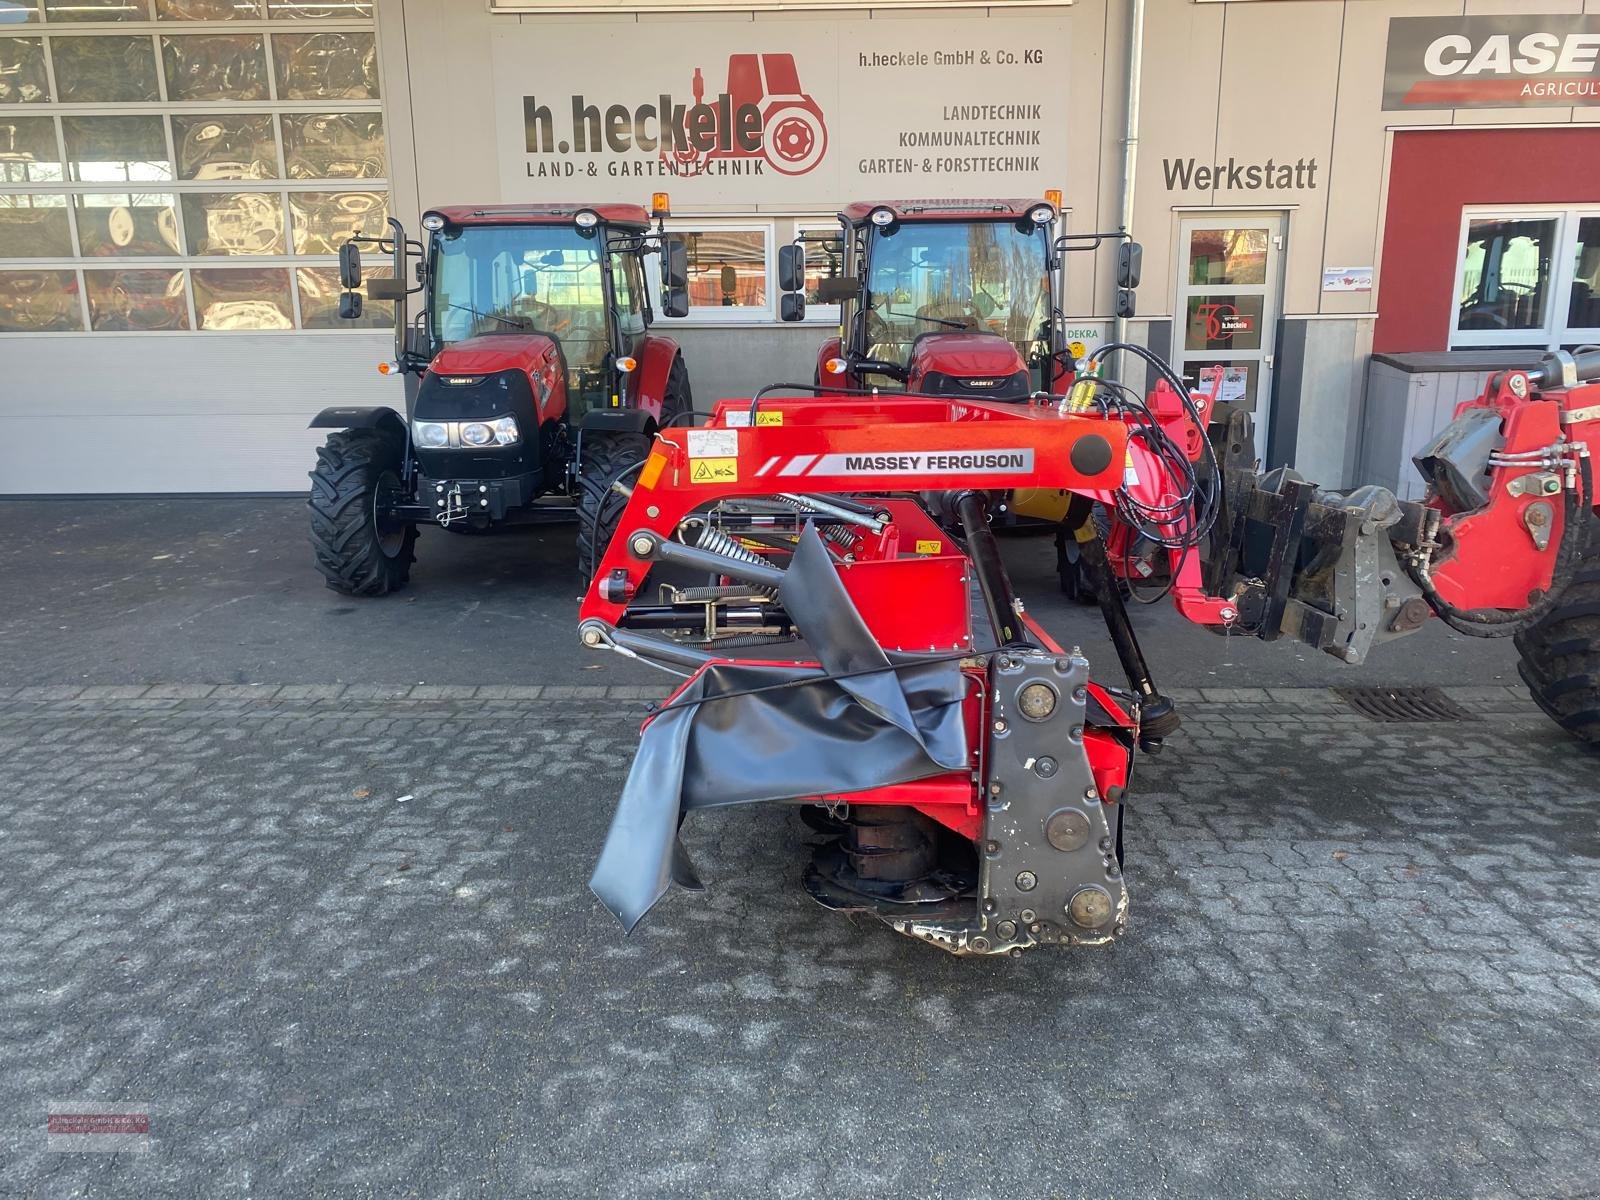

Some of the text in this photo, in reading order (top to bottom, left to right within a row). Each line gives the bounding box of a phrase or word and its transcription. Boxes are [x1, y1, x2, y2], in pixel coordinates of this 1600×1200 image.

[858, 49, 1043, 67] h.heckele GmbH & Co. KG
[1424, 32, 1600, 76] CASE
[943, 105, 1041, 121] LANDTECHNIK
[522, 93, 764, 154] h.heckele
[899, 130, 1041, 147] KOMMUNALTECHNIK
[608, 159, 764, 177] GARTENTECHNIK
[858, 156, 1040, 174] GARTEN- & FORSTTECHNIK
[1162, 157, 1318, 191] Werkstatt
[1067, 329, 1099, 339] DEKRA
[845, 454, 1024, 471] MASSEY FERGUSON
